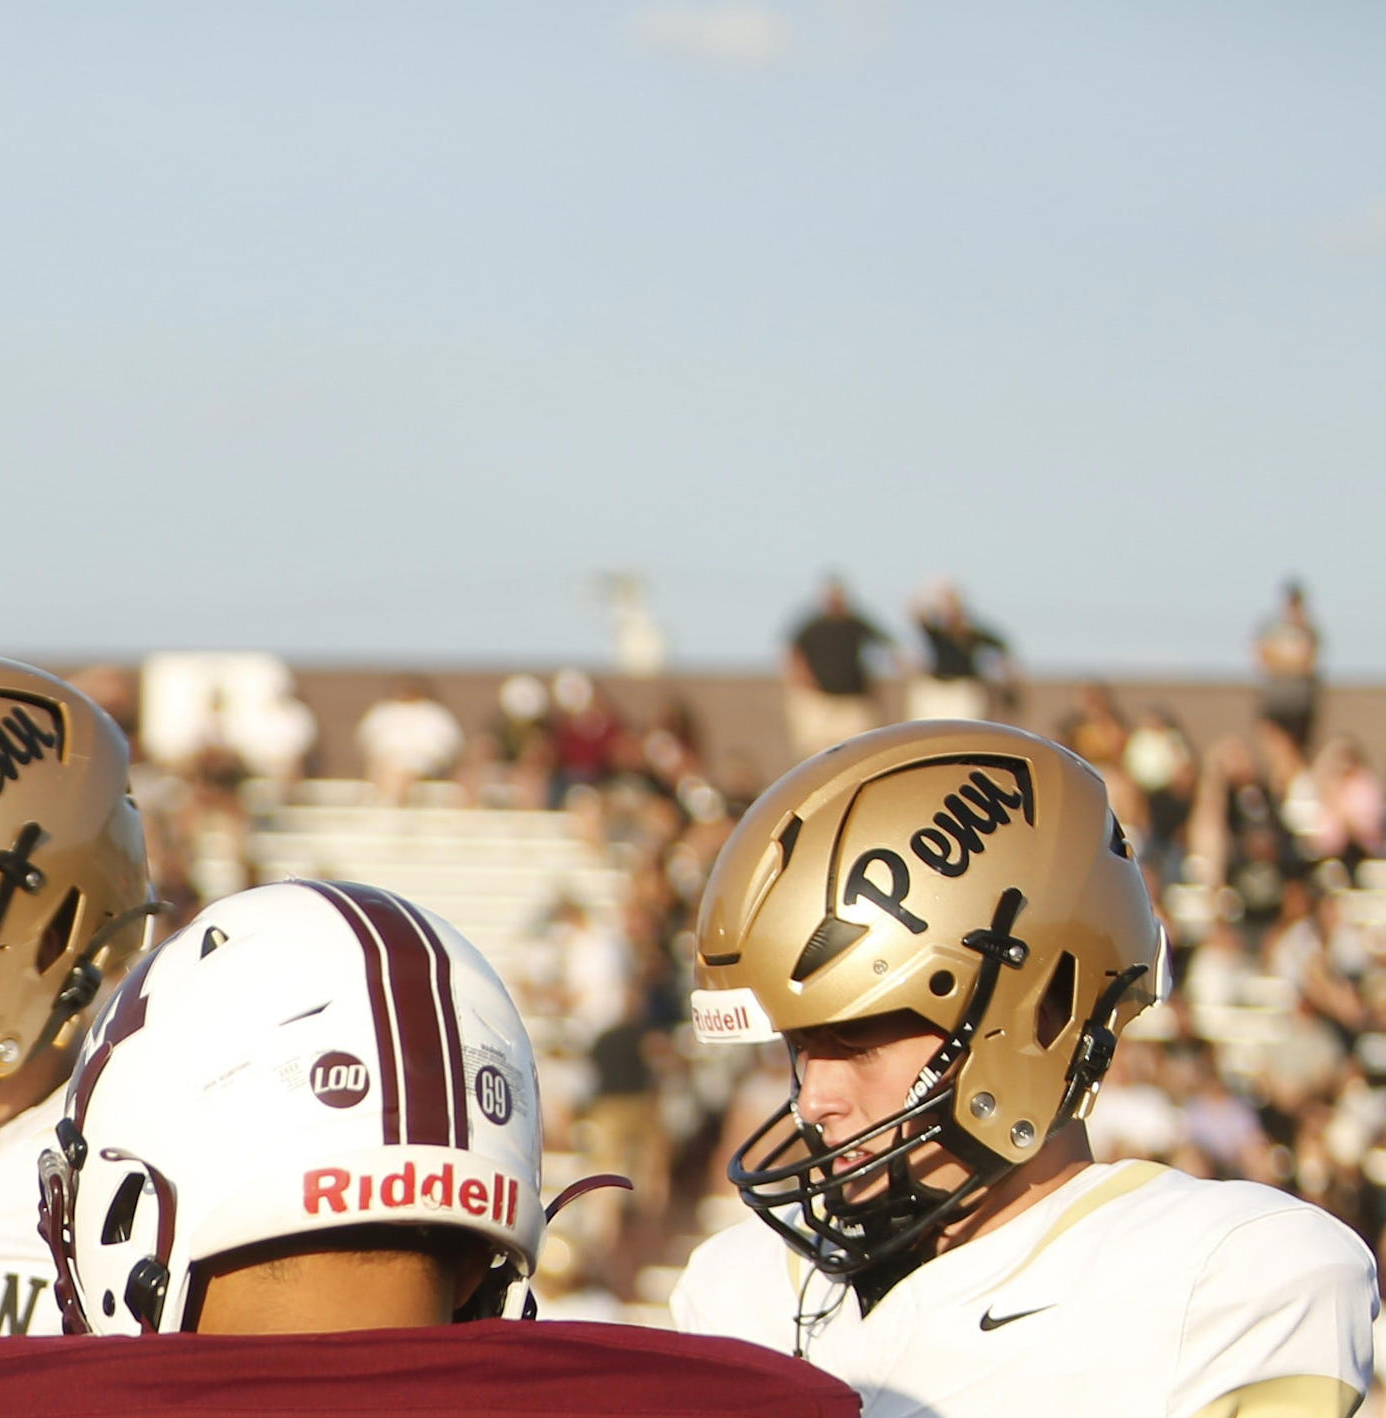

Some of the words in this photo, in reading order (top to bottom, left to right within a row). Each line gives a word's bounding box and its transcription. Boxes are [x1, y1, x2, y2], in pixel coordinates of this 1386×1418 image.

[844, 771, 1027, 934] Penn
[314, 1064, 367, 1095] LOD
[482, 1070, 507, 1119] 69
[303, 1162, 519, 1228] Riddell
